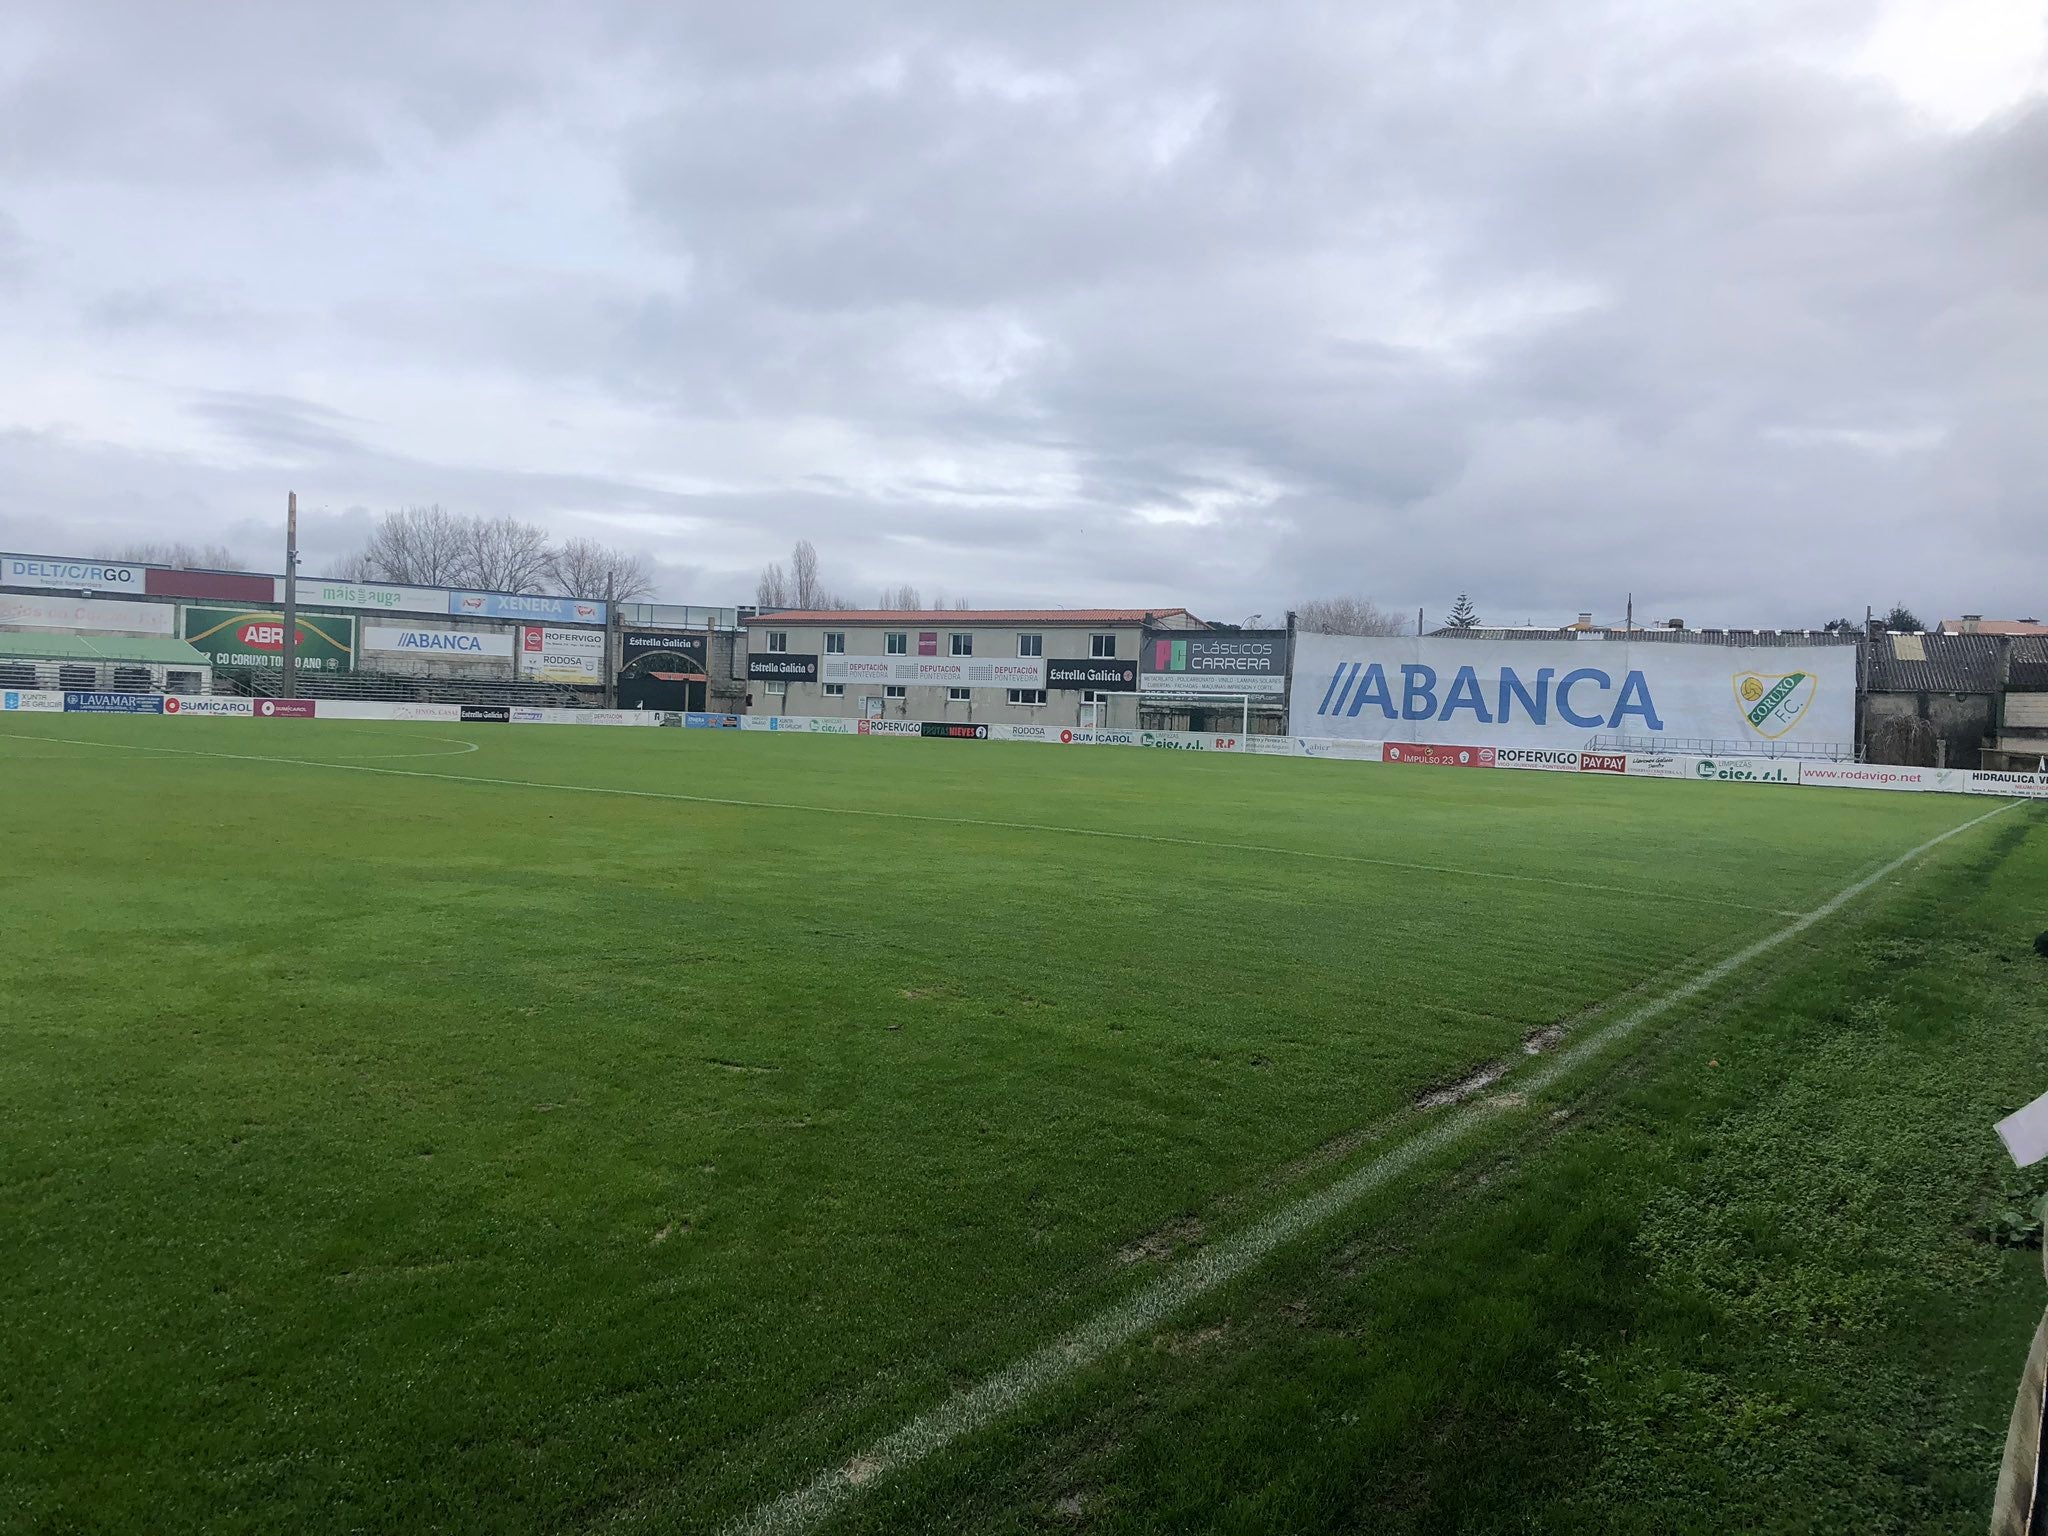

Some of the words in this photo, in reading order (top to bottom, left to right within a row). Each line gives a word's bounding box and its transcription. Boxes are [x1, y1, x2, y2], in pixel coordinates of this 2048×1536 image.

[368, 592, 401, 606] auga
[498, 597, 562, 613] XENERA
[244, 626, 297, 645] ABR
[545, 633, 602, 643] ROFERVIGO
[629, 636, 660, 647] Estrella
[662, 638, 691, 648] Galicia
[231, 654, 268, 666] CORUXO
[303, 657, 322, 669] ANO
[543, 656, 582, 665] RODOSA
[1191, 657, 1270, 671] CARRERA
[750, 662, 778, 673] Estrella
[779, 662, 806, 674] Galicia
[849, 663, 888, 671] DEPUTACIÓN
[919, 664, 961, 673] DEPUTACIÓN
[994, 666, 1038, 675] DEPUTACIÓN
[849, 671, 889, 679] PONTEVEDRA
[919, 673, 961, 681] PONTEVEDRA
[994, 674, 1039, 682] PONTEVEDRA
[1050, 668, 1085, 681] Estrella
[1087, 669, 1121, 682] Galicia
[80, 695, 137, 706] LAVAMAR
[1750, 677, 1795, 723] CORUXO
[462, 710, 483, 718] Estrella
[483, 711, 503, 719] Galicia
[1774, 698, 1804, 724] F.C.
[871, 722, 921, 732] ROFERVIGO
[949, 727, 975, 737] NIEVES
[1012, 726, 1046, 735] RODOSA
[1215, 738, 1236, 748] R.P
[1404, 754, 1440, 764] IMPULSO
[1442, 756, 1454, 765] 23
[1497, 750, 1578, 764] ROFERVIGO
[1583, 757, 1602, 768] PAY
[1603, 758, 1624, 770] PAY
[1803, 768, 1922, 784] www.rodavigo.net
[1972, 772, 2035, 784] HIDRAULICA
